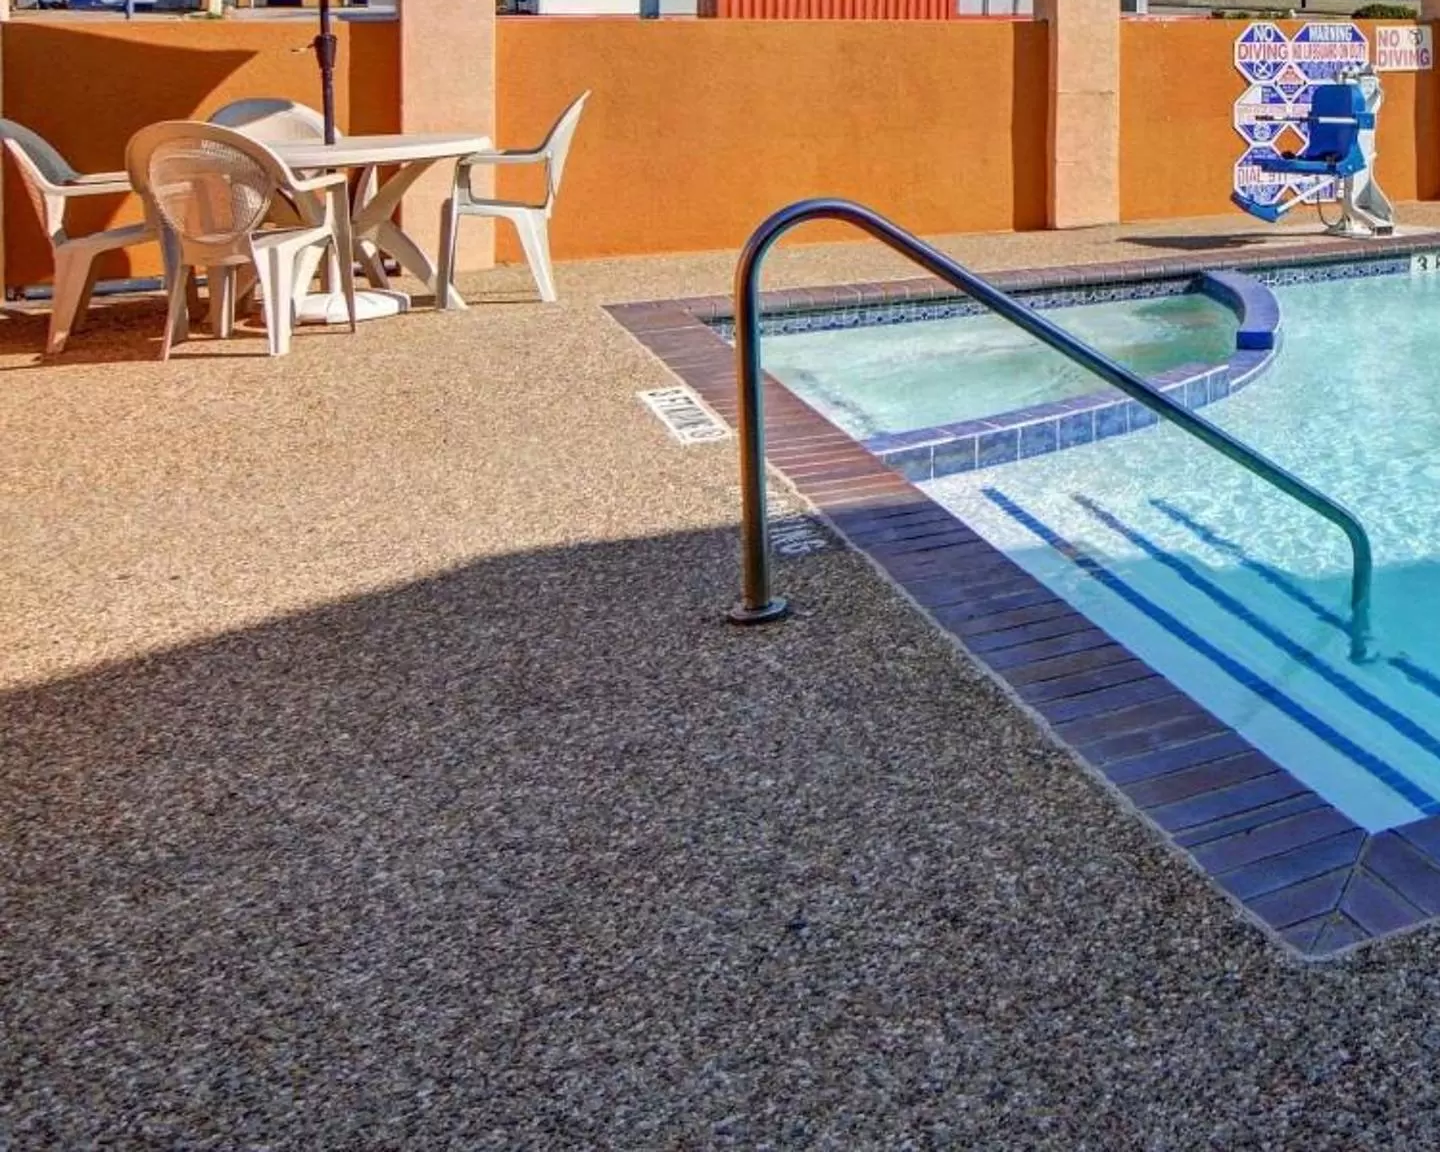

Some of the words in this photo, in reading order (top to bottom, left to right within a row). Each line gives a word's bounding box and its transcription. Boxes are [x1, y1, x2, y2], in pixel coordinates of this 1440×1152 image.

[1253, 25, 1274, 41] NO
[1309, 26, 1353, 41] WARNING
[1378, 30, 1400, 46] NO
[1238, 44, 1289, 60] DIVING
[1379, 48, 1430, 67] DIVING
[1237, 168, 1264, 183] DIAL
